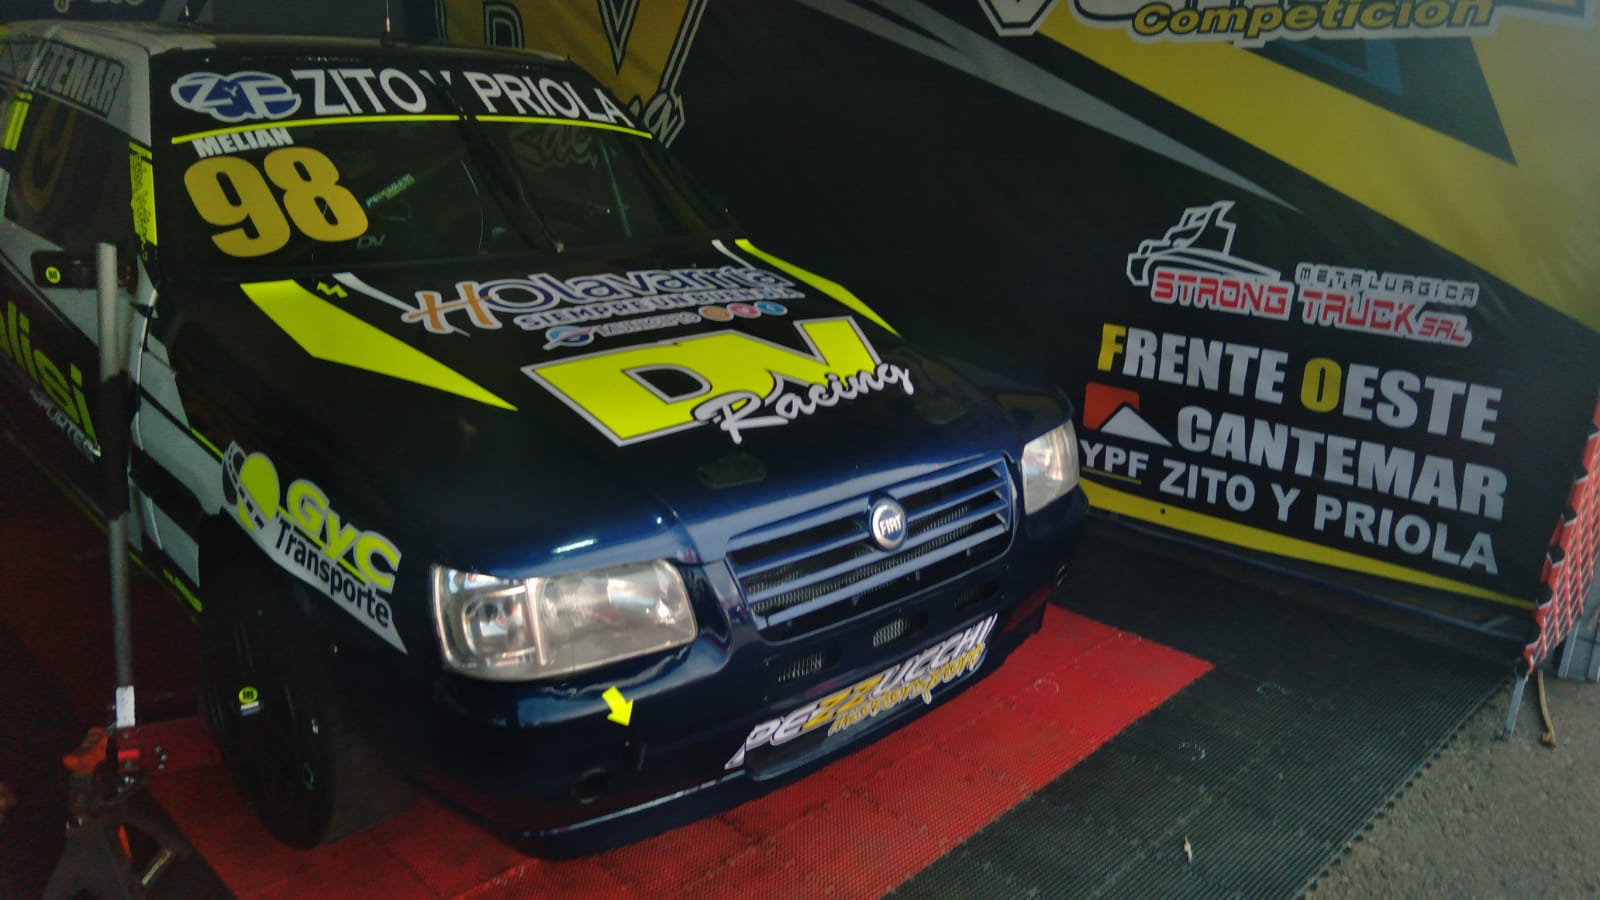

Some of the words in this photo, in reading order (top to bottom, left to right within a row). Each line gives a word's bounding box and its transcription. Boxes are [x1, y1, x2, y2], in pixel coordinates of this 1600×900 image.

[291, 67, 427, 116] ZITO
[463, 70, 636, 129] PRIOLA
[192, 127, 294, 158] MELIAN
[183, 146, 369, 258] 98
[516, 297, 655, 330] SIEMPRE
[651, 291, 690, 309] UN
[1153, 272, 1290, 316] STRONG
[1302, 289, 1417, 335] TRUCK
[1417, 316, 1467, 343] SRL
[1297, 266, 1477, 305] METALURGICA
[520, 316, 882, 448] DV
[690, 362, 914, 444] Racing
[1097, 322, 1289, 404] FRENTE
[1300, 357, 1503, 446] OESTE
[1080, 439, 1150, 478] YPF
[1176, 404, 1508, 520] CANTEMAR
[879, 514, 902, 536] FIAT
[1159, 458, 1255, 513] ZITO
[1270, 482, 1301, 522] Y
[1313, 494, 1499, 576] PRIOLA
[275, 517, 390, 628] Transporte
